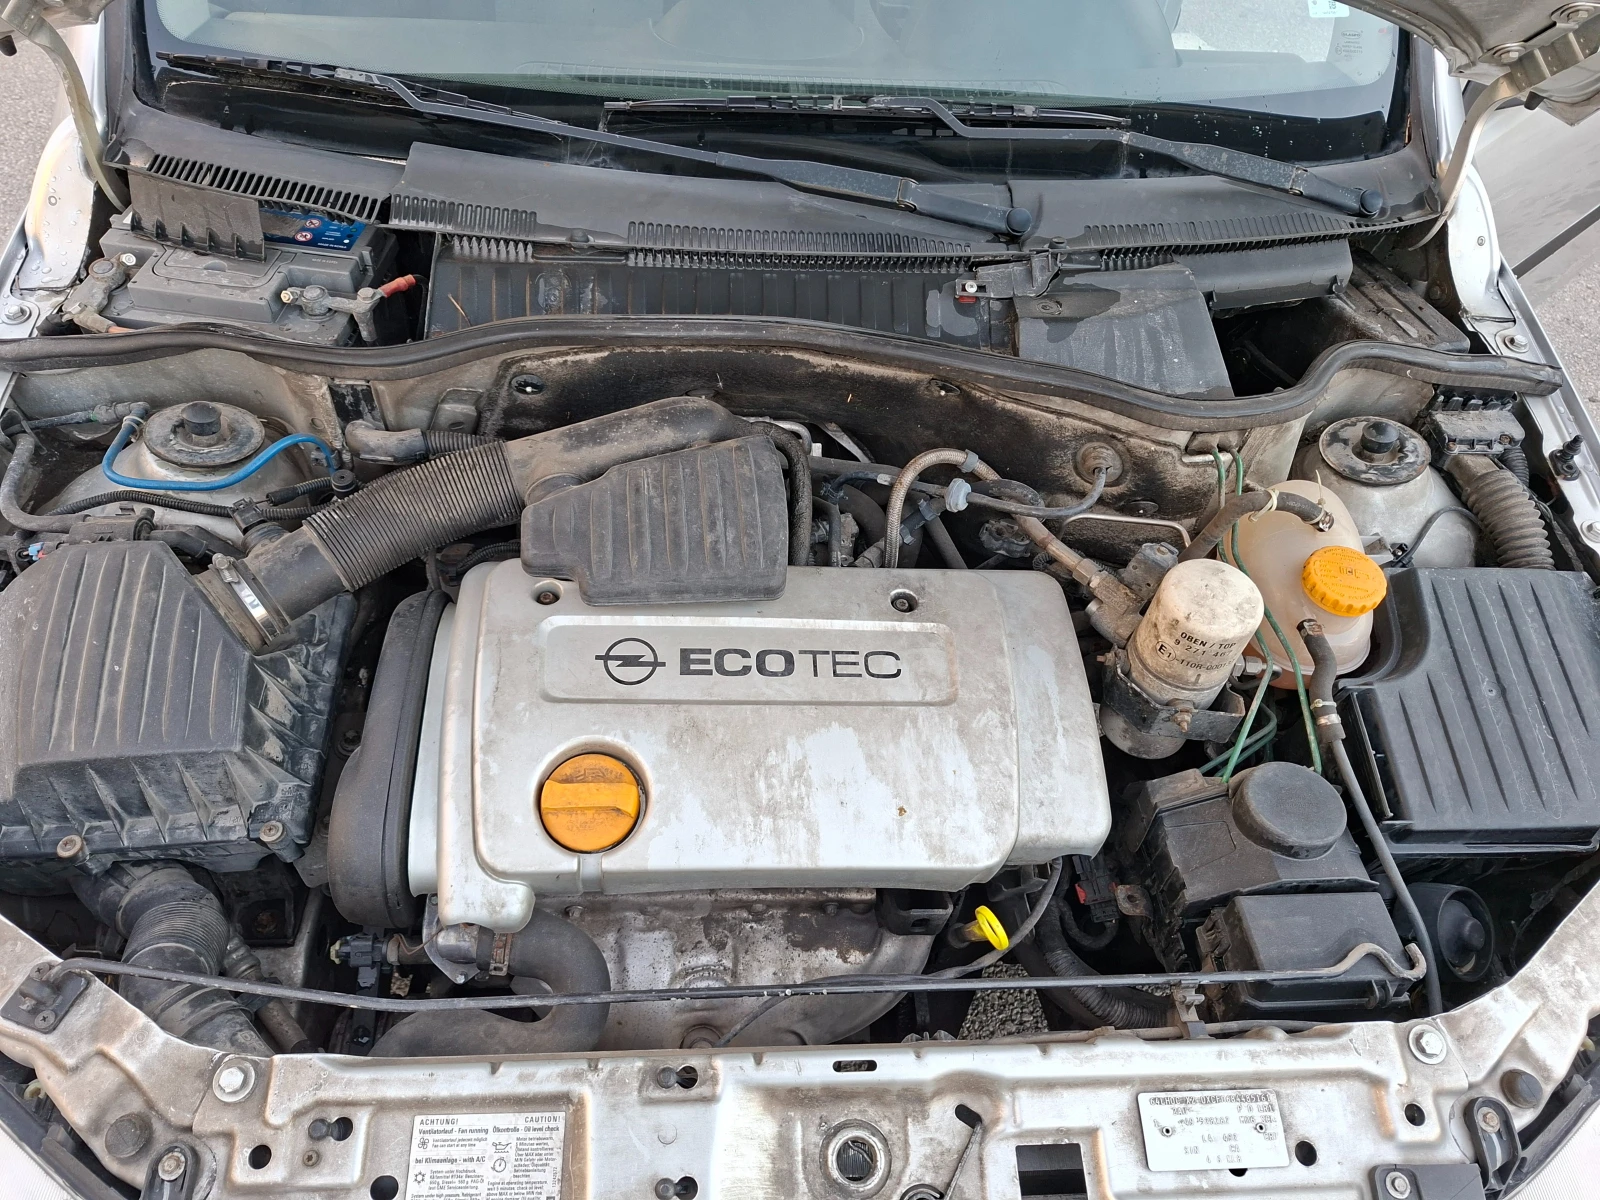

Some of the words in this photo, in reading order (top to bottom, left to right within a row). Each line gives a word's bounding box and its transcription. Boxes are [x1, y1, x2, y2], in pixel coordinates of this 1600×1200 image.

[1180, 632, 1207, 647] OBEN
[679, 648, 902, 679] ECOTEC
[469, 1127, 488, 1135] running
